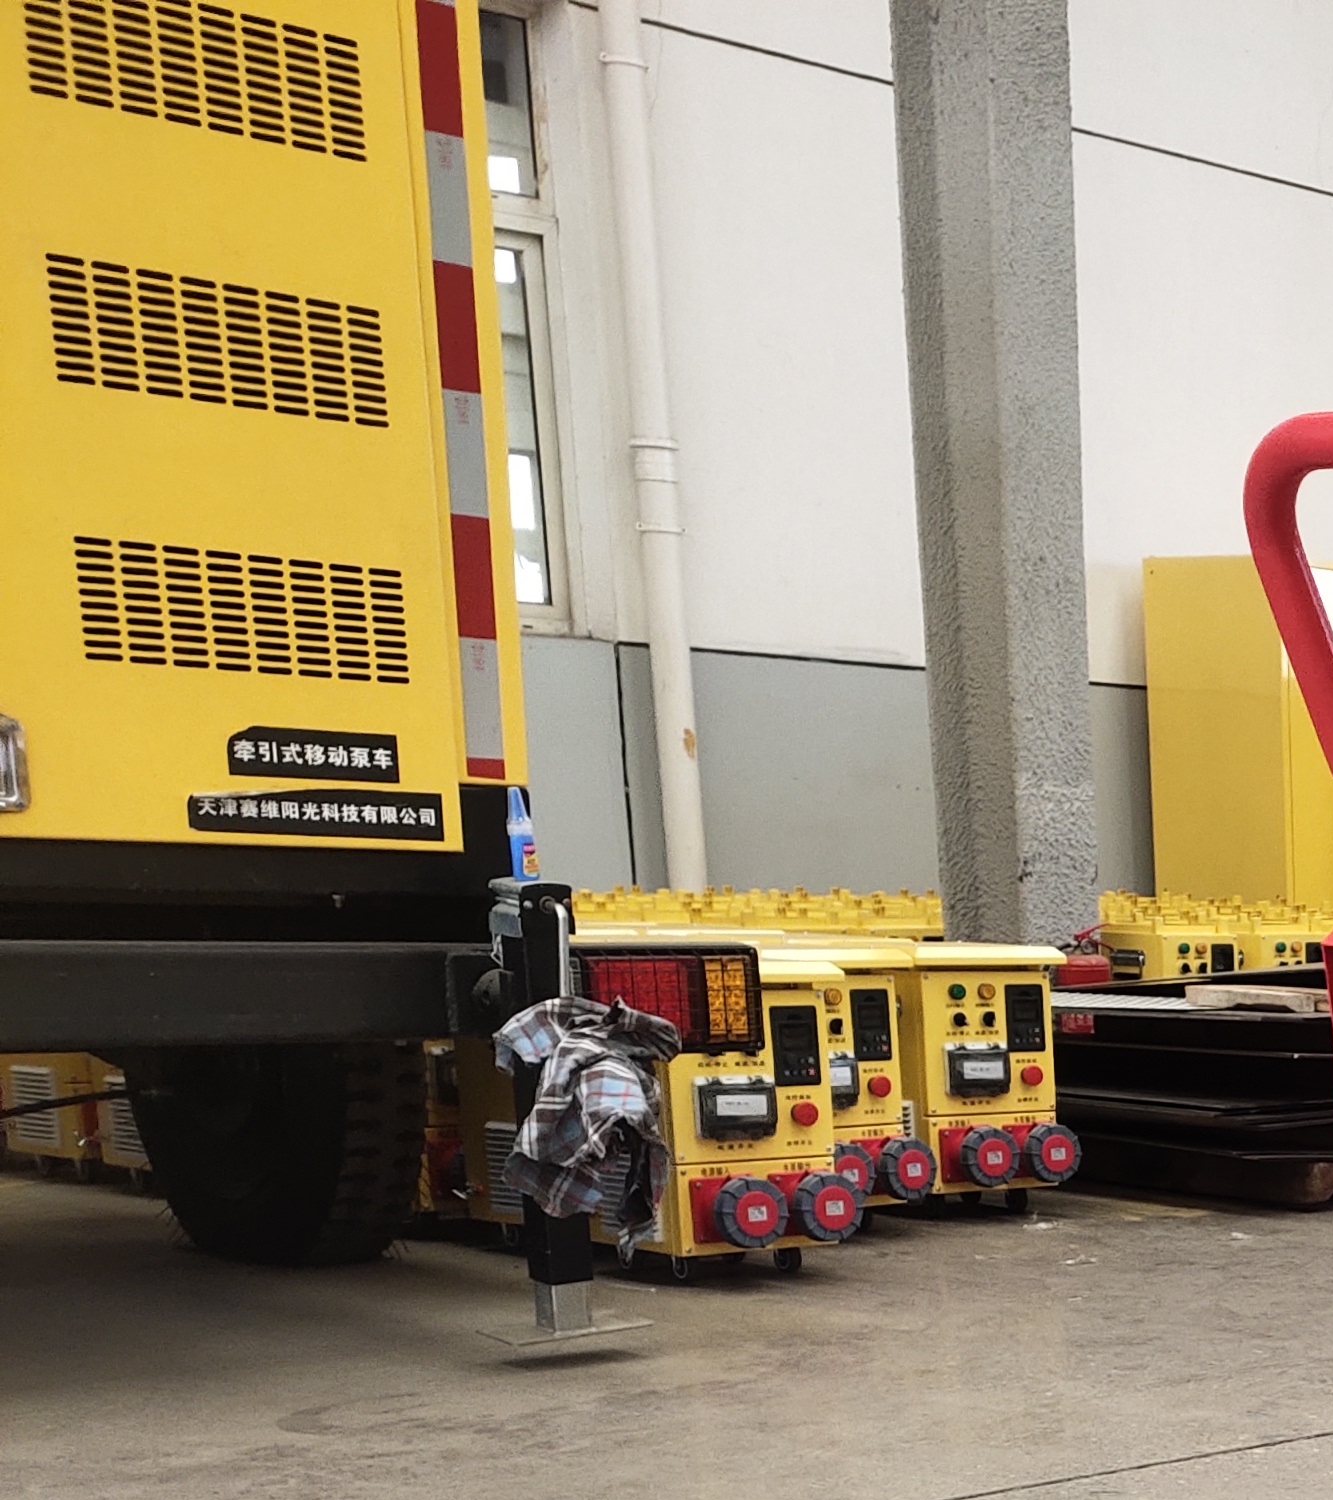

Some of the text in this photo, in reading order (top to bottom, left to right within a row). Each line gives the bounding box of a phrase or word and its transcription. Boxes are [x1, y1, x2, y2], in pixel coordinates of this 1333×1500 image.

[233, 738, 394, 770] 牵引式移动泵车
[197, 798, 437, 827] 天津赛维阳光科技有限公司
